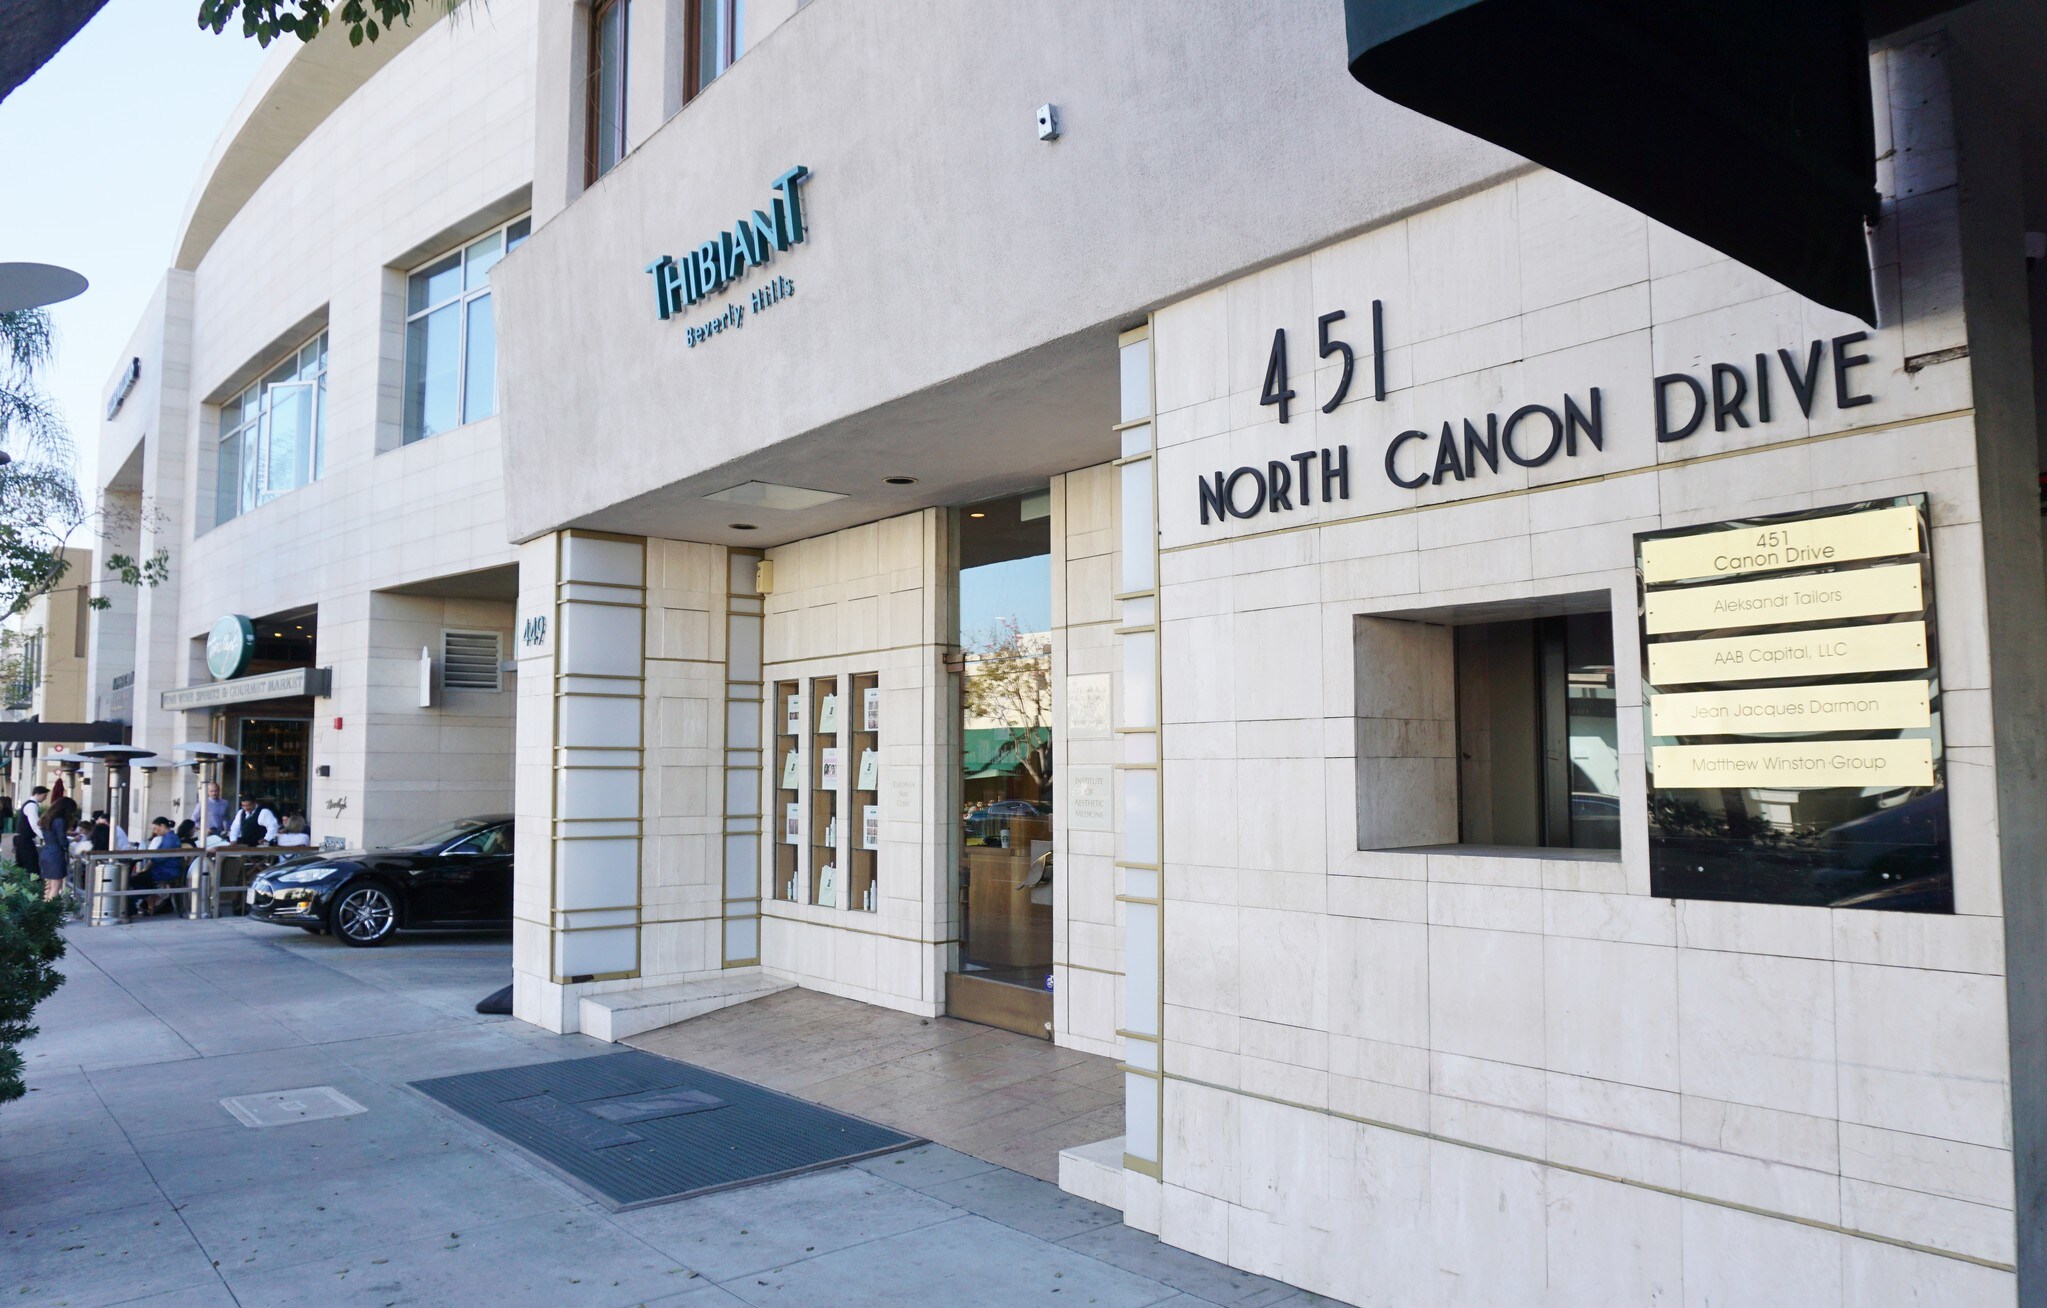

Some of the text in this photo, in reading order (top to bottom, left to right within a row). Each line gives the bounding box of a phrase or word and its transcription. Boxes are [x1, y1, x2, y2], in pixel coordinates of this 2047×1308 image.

[645, 165, 809, 320] THIBIANT
[685, 275, 795, 348] Beverly Hills
[1260, 299, 1386, 424] 451
[1199, 330, 1874, 525] NORTH CANON DRIVE
[1756, 530, 1789, 548] 451
[1714, 545, 1835, 571] Canon Drive
[1713, 590, 1842, 613] Aleksandr Tailors
[523, 615, 546, 646] 449
[1714, 642, 1848, 665] AAB Capital, LLC
[222, 687, 228, 698] &
[229, 682, 266, 697] GOURMET
[267, 676, 303, 692] MARKET
[1691, 699, 1879, 719] Jean Jacques Darmon
[1692, 755, 1887, 772] Matthew Winston Group
[1074, 776, 1104, 785] INSTITUTE
[1085, 787, 1094, 796] OF
[1074, 799, 1104, 807] AESTHETIC
